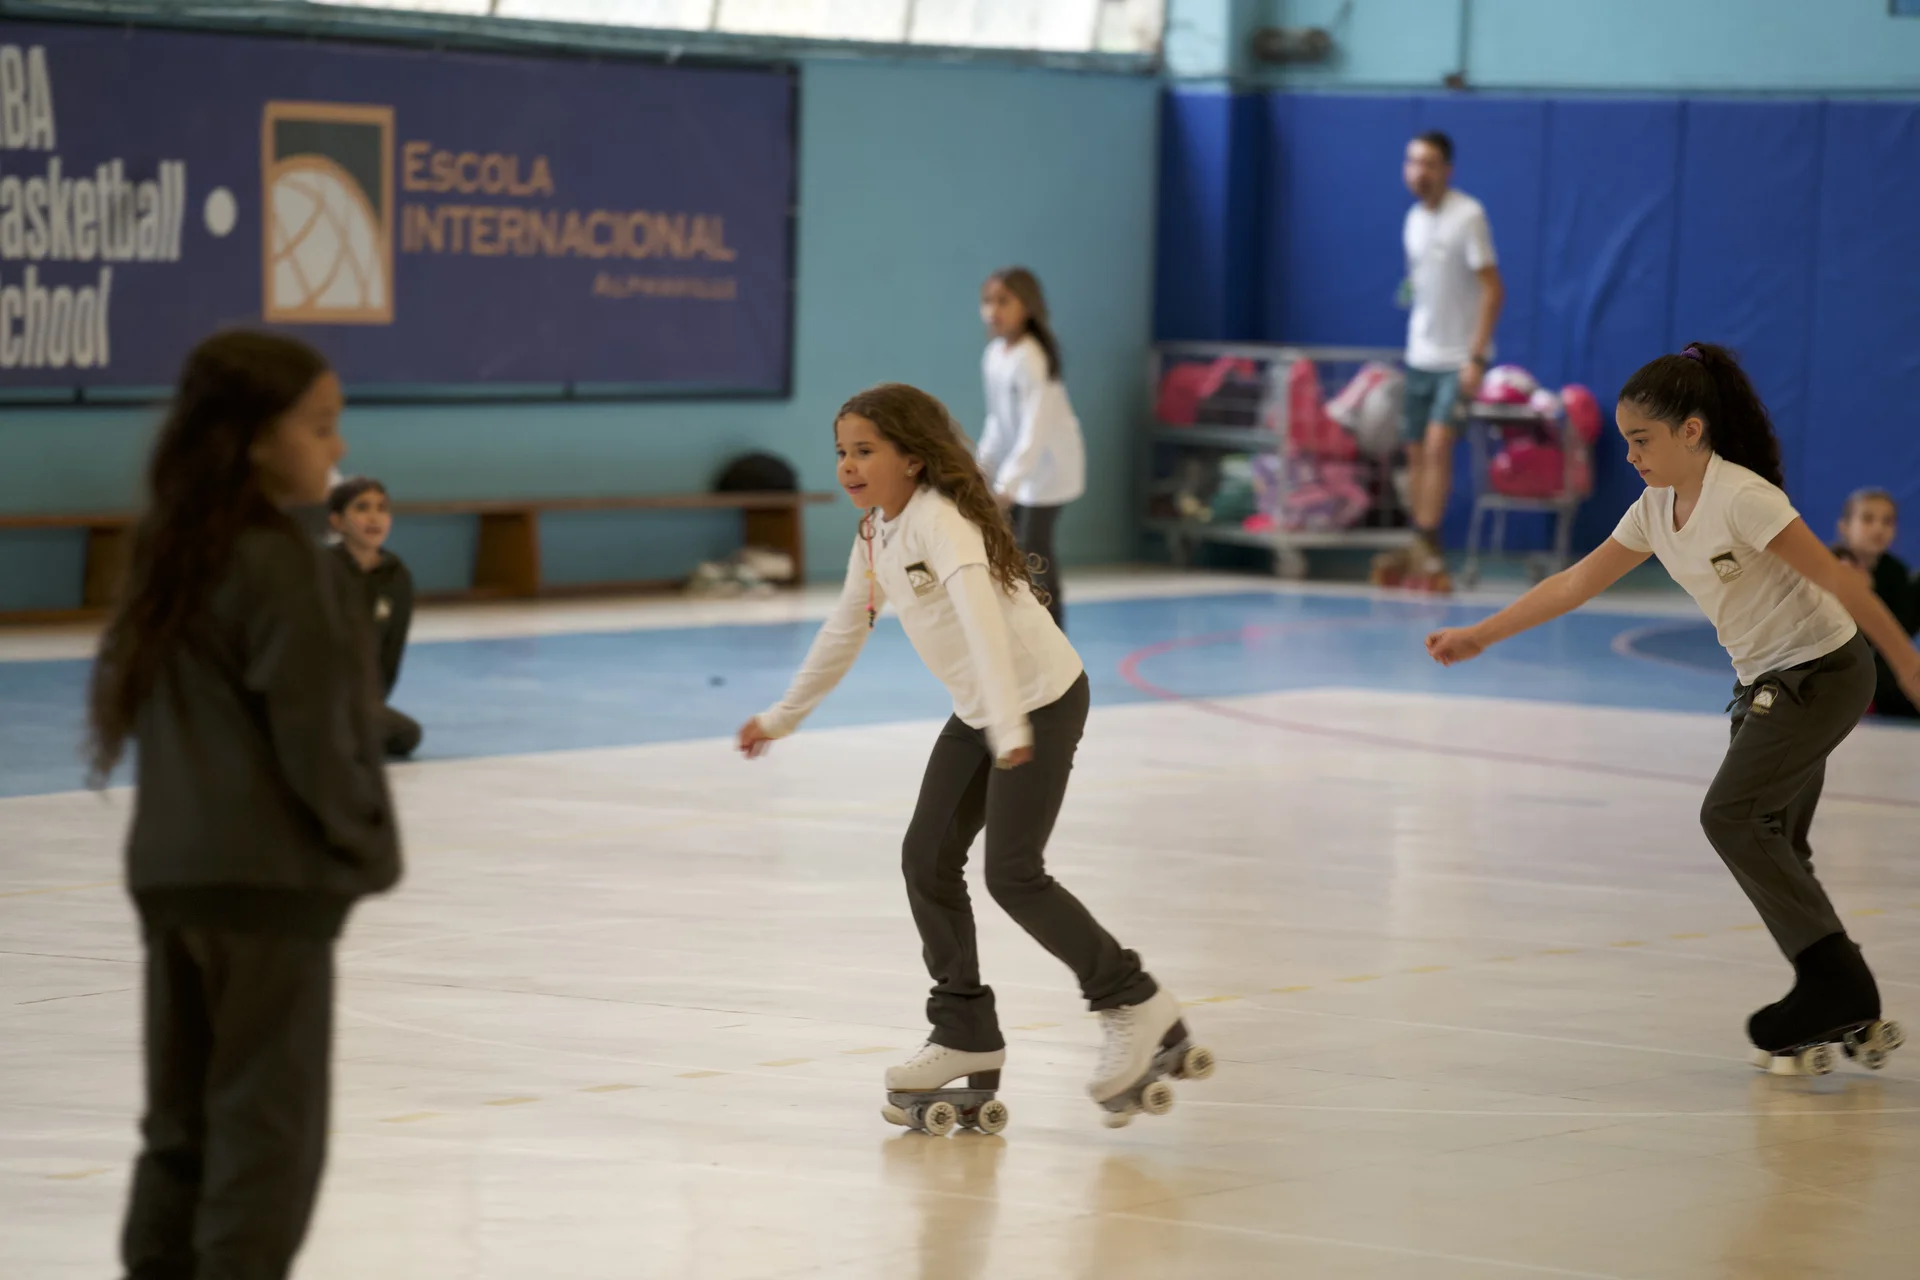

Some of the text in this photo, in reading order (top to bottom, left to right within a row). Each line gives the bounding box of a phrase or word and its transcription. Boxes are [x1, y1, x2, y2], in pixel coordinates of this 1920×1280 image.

[0, 45, 55, 149] BA
[0, 156, 184, 261] asketball
[402, 141, 554, 196] ESCOLA
[402, 205, 737, 261] INTERNACIONAL
[0, 265, 112, 367] chool
